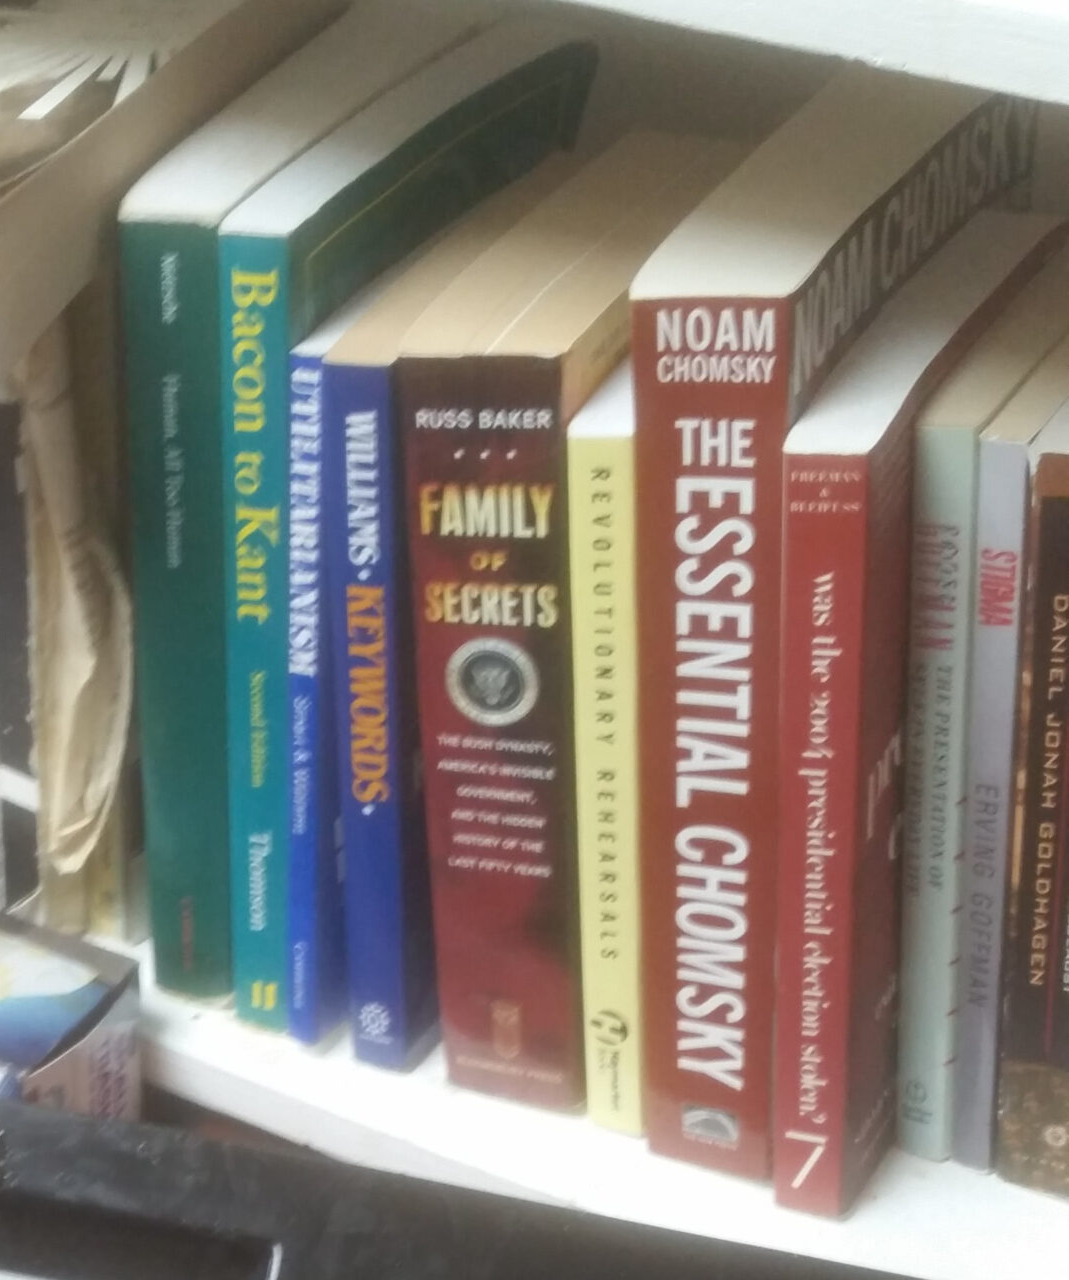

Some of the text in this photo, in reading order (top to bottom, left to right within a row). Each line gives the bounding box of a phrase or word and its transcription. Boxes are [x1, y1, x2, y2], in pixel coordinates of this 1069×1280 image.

[656, 307, 776, 354] NOAM
[656, 354, 777, 383] CHOMSKY
[231, 267, 281, 625] Bacon to Kant
[416, 409, 552, 431] RUSS BAKER
[673, 418, 758, 469] THE
[288, 366, 323, 677] UTILITARIANISM
[419, 482, 555, 538] FAMILY
[469, 551, 508, 572] OF
[345, 410, 392, 804] WILLIAMS KEYWORDS
[425, 584, 559, 629] SECRETS
[673, 475, 757, 809] ESSENTIAL
[437, 734, 460, 748] THE
[462, 736, 494, 751] BUSH
[591, 467, 619, 962] REVOLUTIONARY REHEARSALS
[967, 548, 1018, 1009] STIGMA ERVING GOFFMAN
[1029, 594, 1069, 986] DANIEL JONAH GOLDHAGEN
[477, 811, 500, 825] THE
[501, 837, 519, 850] OF
[521, 840, 545, 853] THE
[448, 856, 478, 870] LAST
[478, 858, 512, 873] FIFTY
[797, 571, 844, 1124] was the 2004 presidential election stolen?
[249, 831, 273, 931] Thomson
[674, 824, 751, 1091] CHOMSKY
